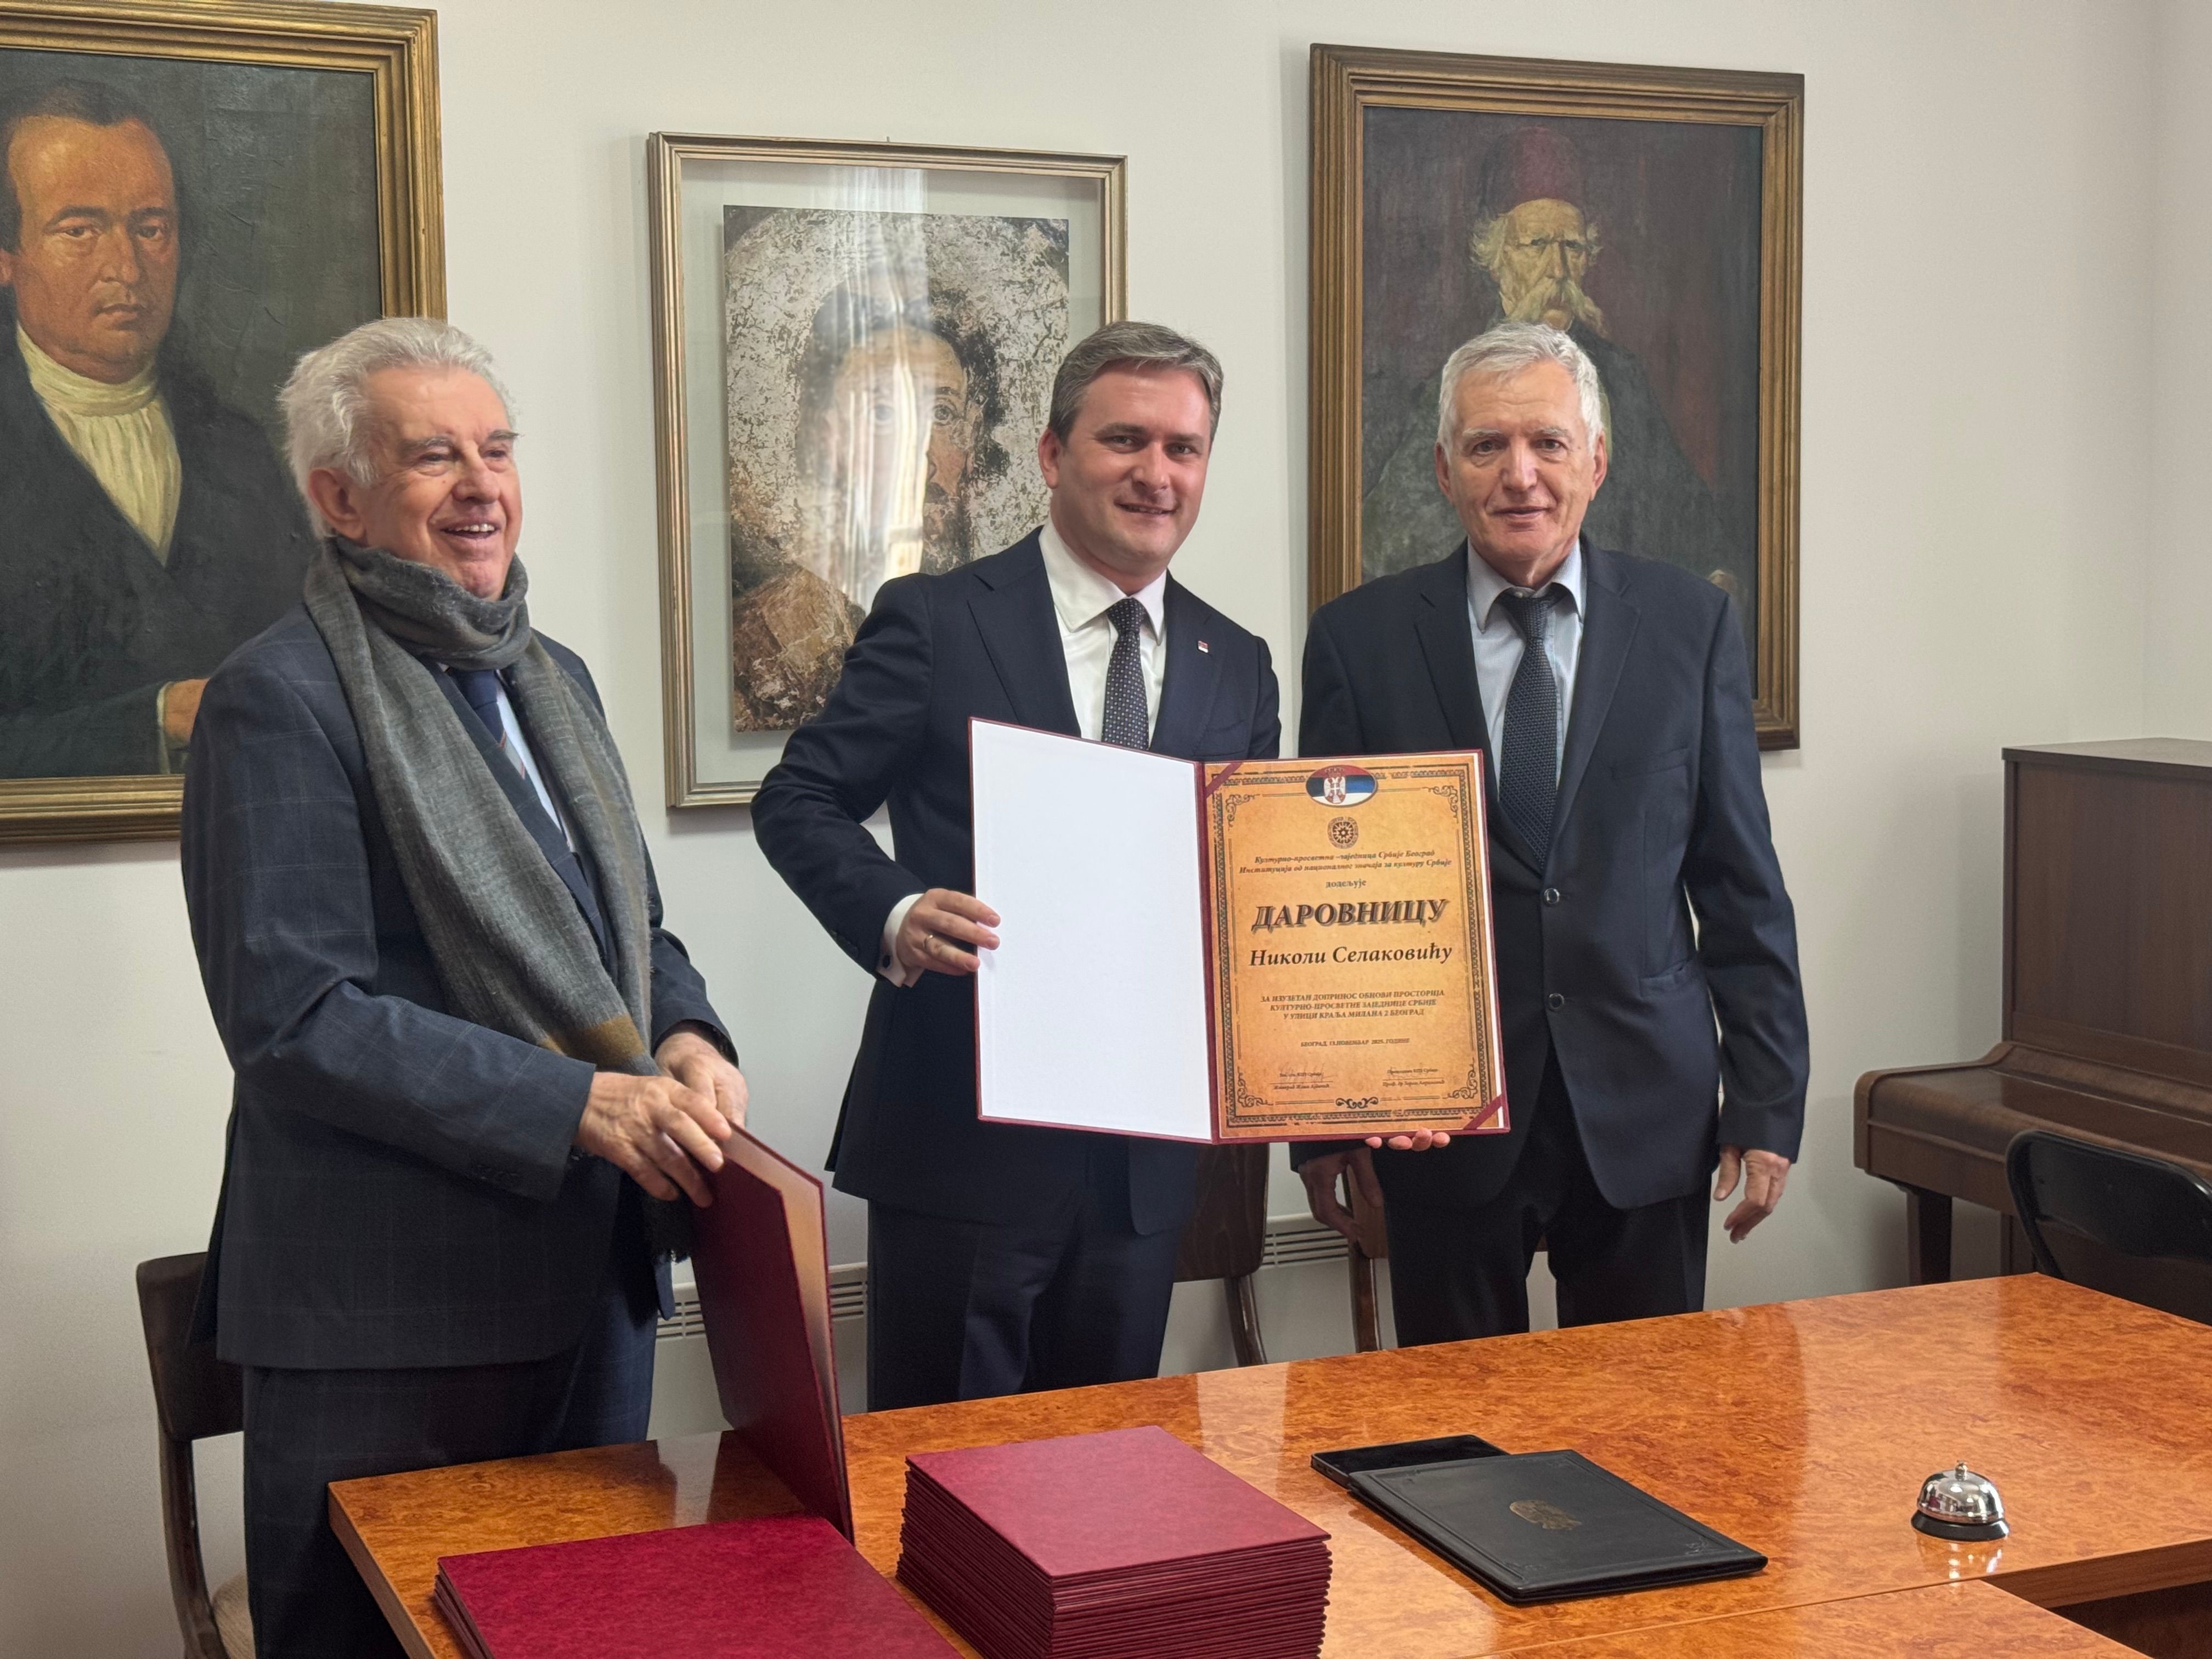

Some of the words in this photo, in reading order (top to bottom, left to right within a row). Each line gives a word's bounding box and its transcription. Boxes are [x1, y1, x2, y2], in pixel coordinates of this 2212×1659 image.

[1378, 851, 1404, 860] Србије
[1405, 850, 1436, 858] Београд
[1239, 865, 1292, 874] Институција
[1393, 861, 1425, 869] културу
[1426, 859, 1452, 868] Србије
[1325, 878, 1367, 889] додељује
[1251, 898, 1450, 933] ДАРОВНИЦУ
[1249, 949, 1326, 967] Николи
[1332, 942, 1453, 964] Селаковићу
[1272, 994, 1312, 1002] ИЗУЗЕТАН
[1312, 992, 1357, 1001] ДОПРИНОС
[1358, 991, 1392, 999] ОБНОВИ
[1393, 989, 1446, 998] ПРОСТОРИЈА
[1270, 1001, 1361, 1011] КУЛТУРНО-ПРОСВЕТНЕ
[1362, 1000, 1407, 1009] ЗАЈЕДНИЦЕ
